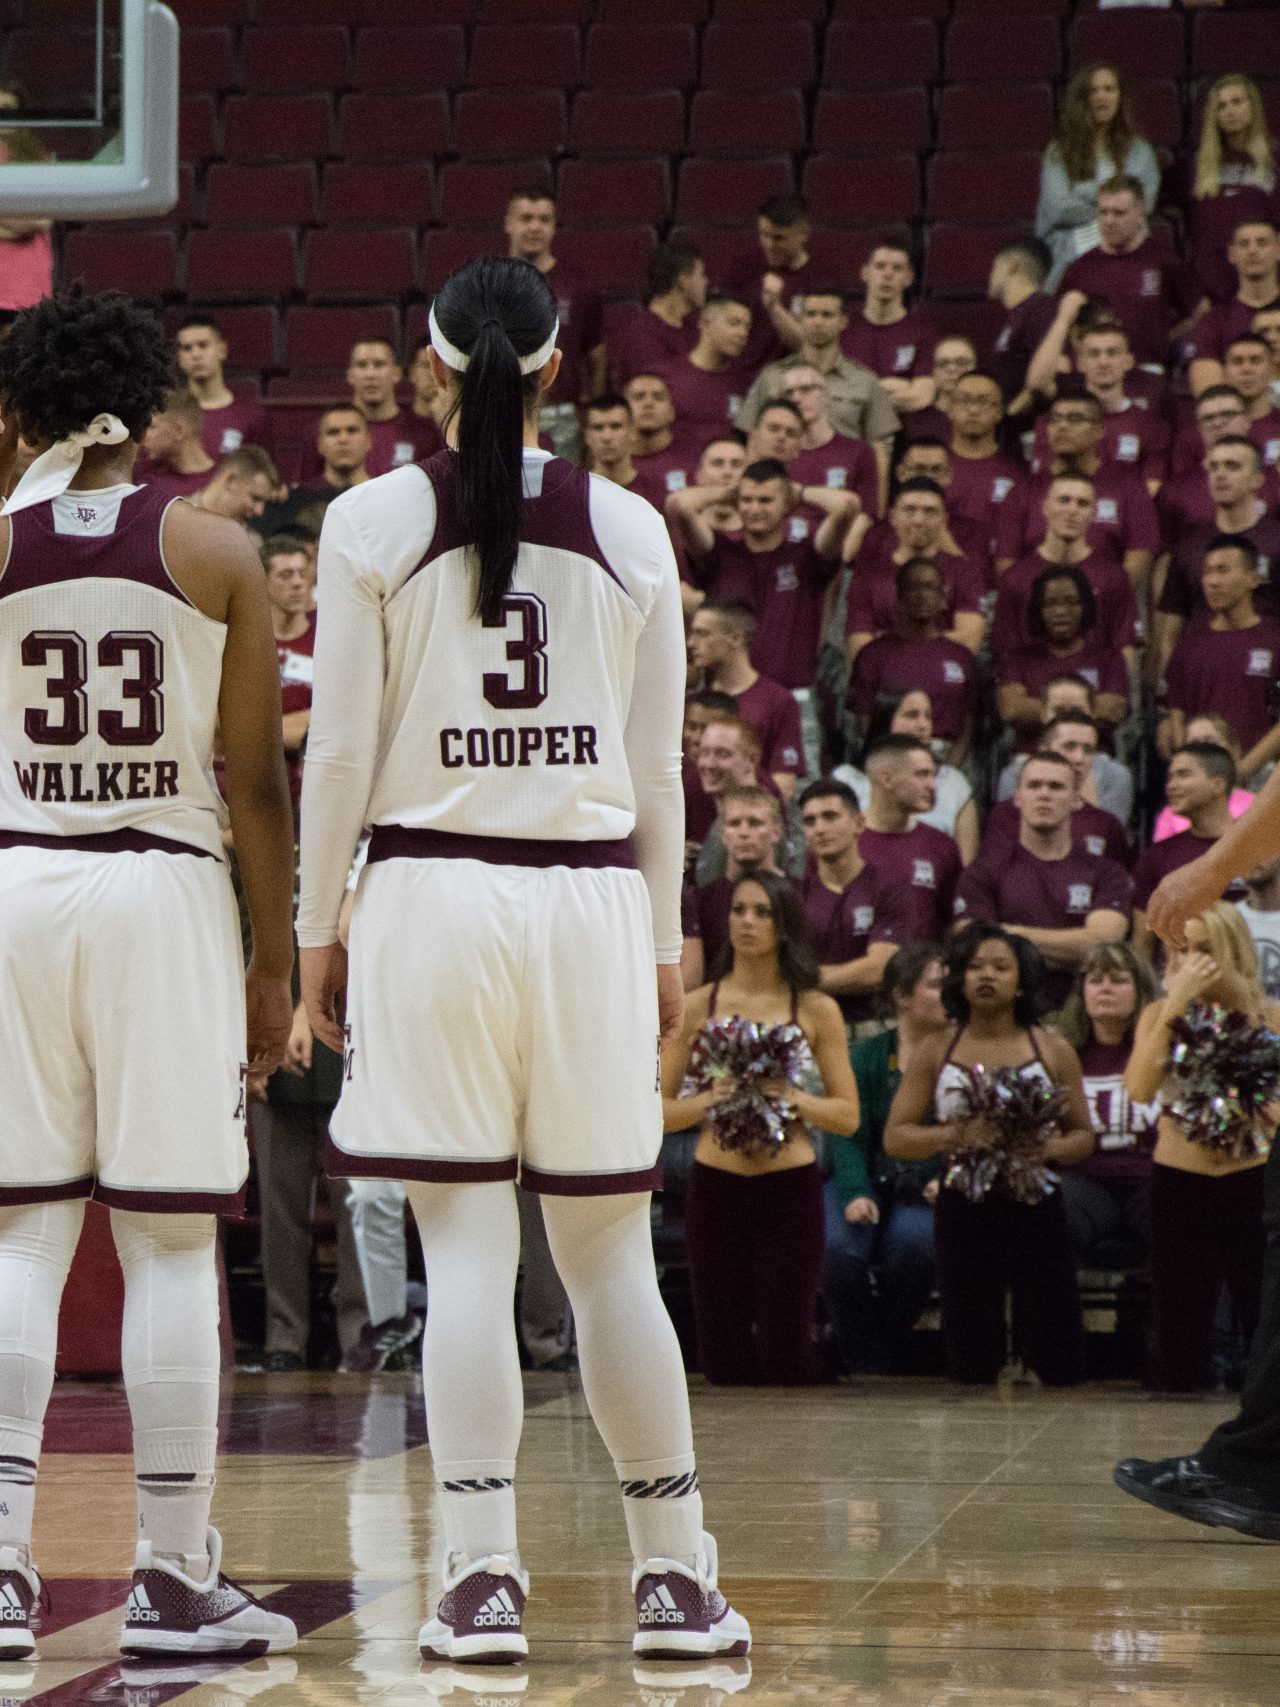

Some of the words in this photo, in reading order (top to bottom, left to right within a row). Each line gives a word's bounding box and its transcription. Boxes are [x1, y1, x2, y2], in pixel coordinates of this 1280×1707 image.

[481, 592, 548, 709] 3
[21, 630, 164, 746] 33
[440, 725, 599, 768] COOPER
[13, 760, 179, 802] WALKER
[473, 1610, 521, 1627] adidas
[638, 1608, 685, 1624] adidas
